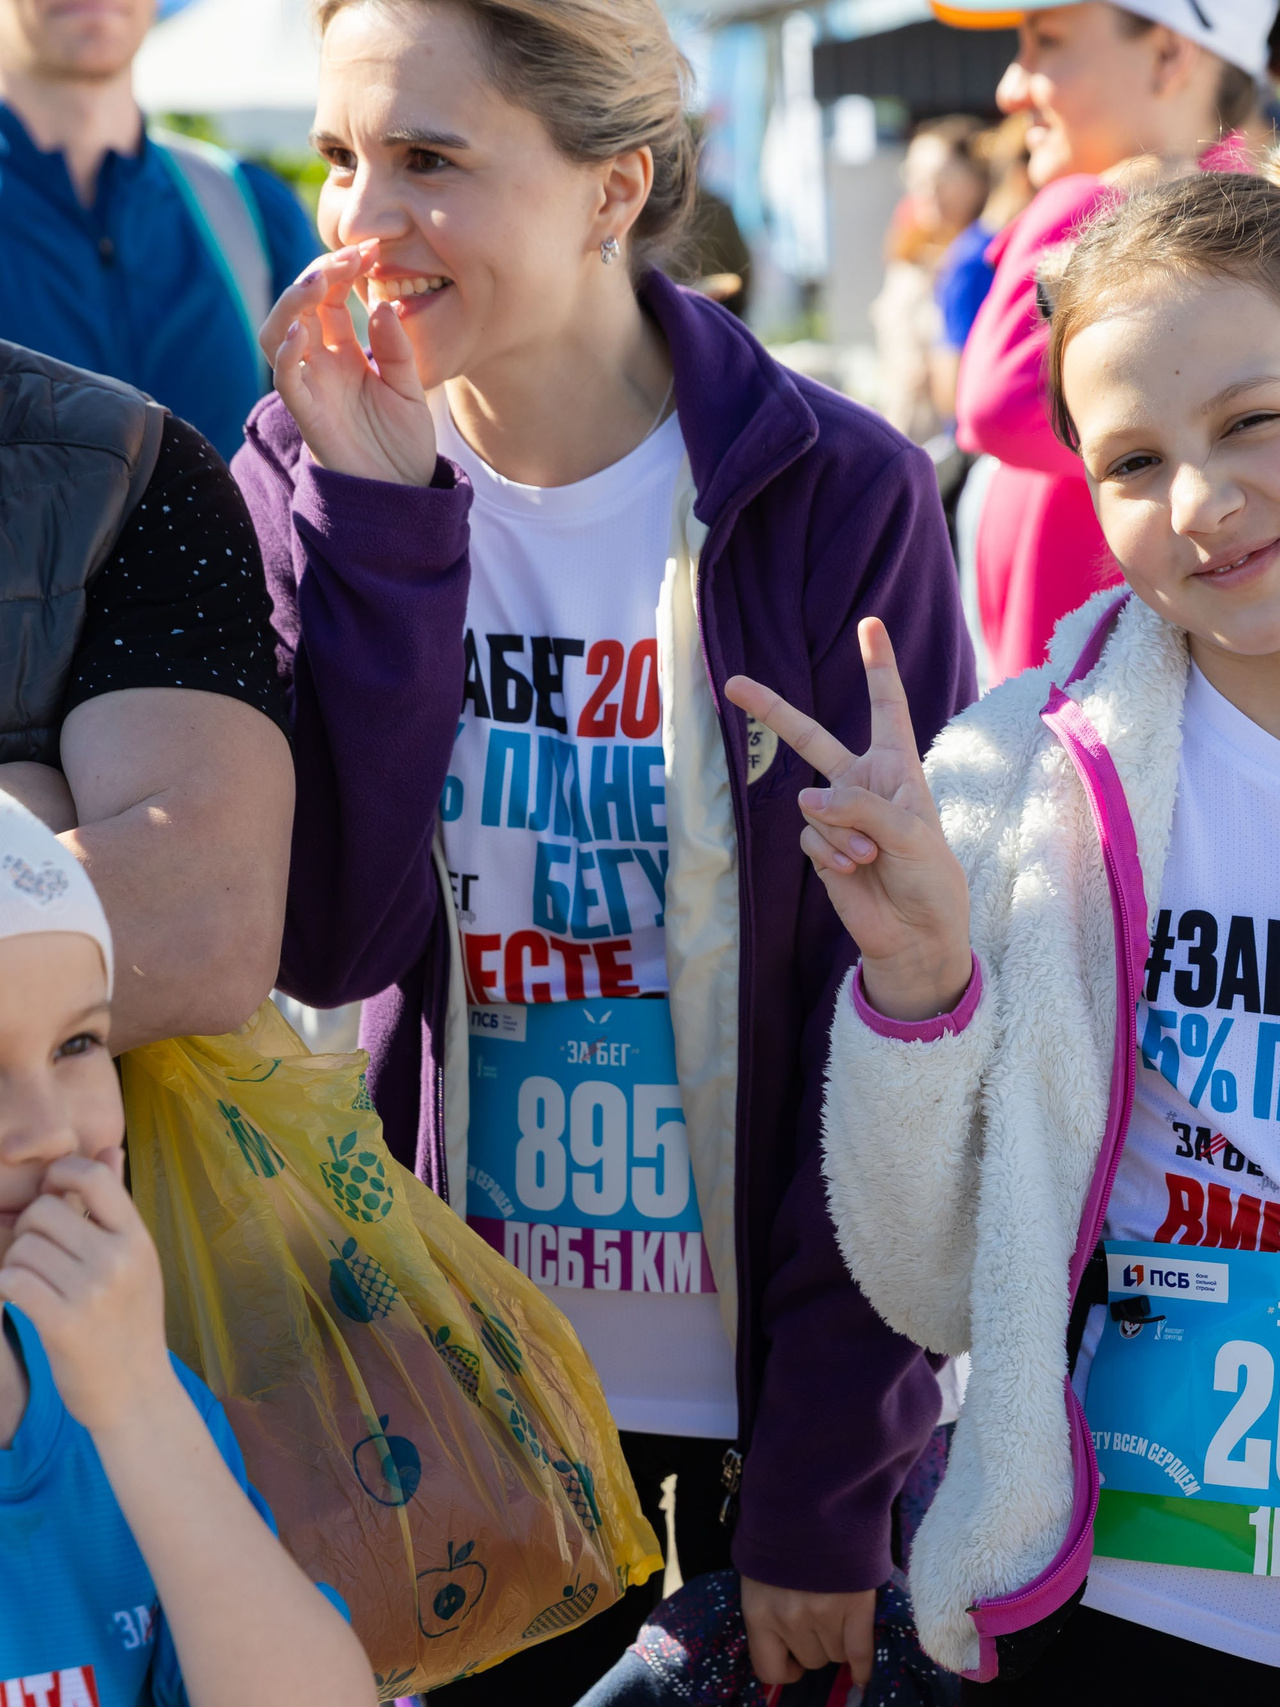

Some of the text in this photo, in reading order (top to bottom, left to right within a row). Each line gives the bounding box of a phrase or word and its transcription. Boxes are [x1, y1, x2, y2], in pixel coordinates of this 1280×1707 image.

[459, 929, 640, 1005] ЕСТЕ
[471, 1011, 499, 1029] ПСБ
[1136, 1003, 1238, 1113] 5%
[515, 1075, 690, 1219] 895
[504, 1220, 585, 1289] ПСБ
[593, 1228, 622, 1290] 5
[1150, 1269, 1190, 1289] ПСБ
[1112, 1432, 1149, 1457] ВСЕМ
[1147, 1442, 1201, 1497] СЕРДЦЕМ
